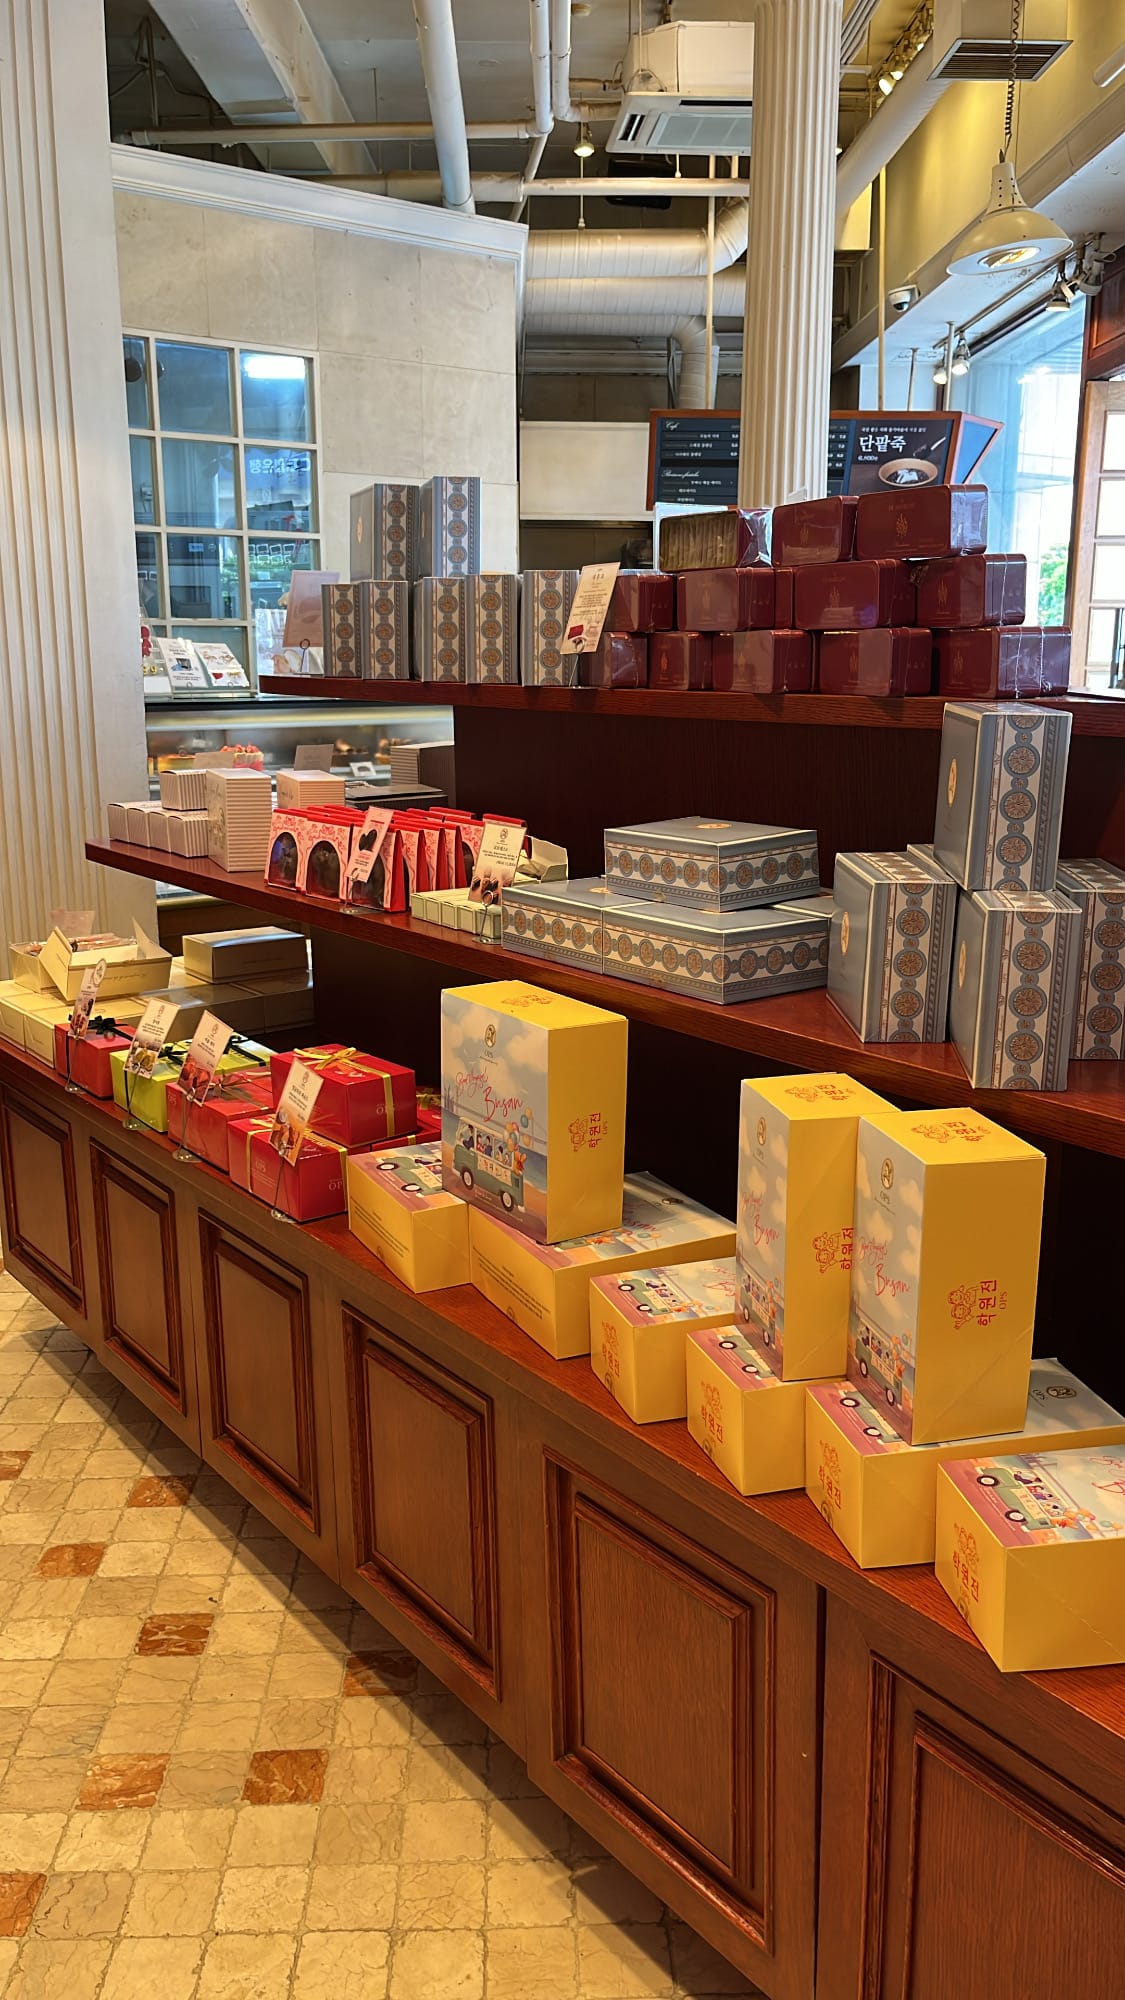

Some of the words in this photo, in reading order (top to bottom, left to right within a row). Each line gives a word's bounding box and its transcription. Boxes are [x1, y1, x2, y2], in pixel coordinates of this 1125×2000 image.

[859, 434, 906, 453] 단팥죽
[483, 1086, 523, 1122] Busan
[587, 1112, 601, 1150] 학원전
[329, 1182, 343, 1192] OP
[875, 1263, 911, 1297] Busan
[976, 1280, 997, 1326] 학원전
[953, 1550, 979, 1602] 학원전
